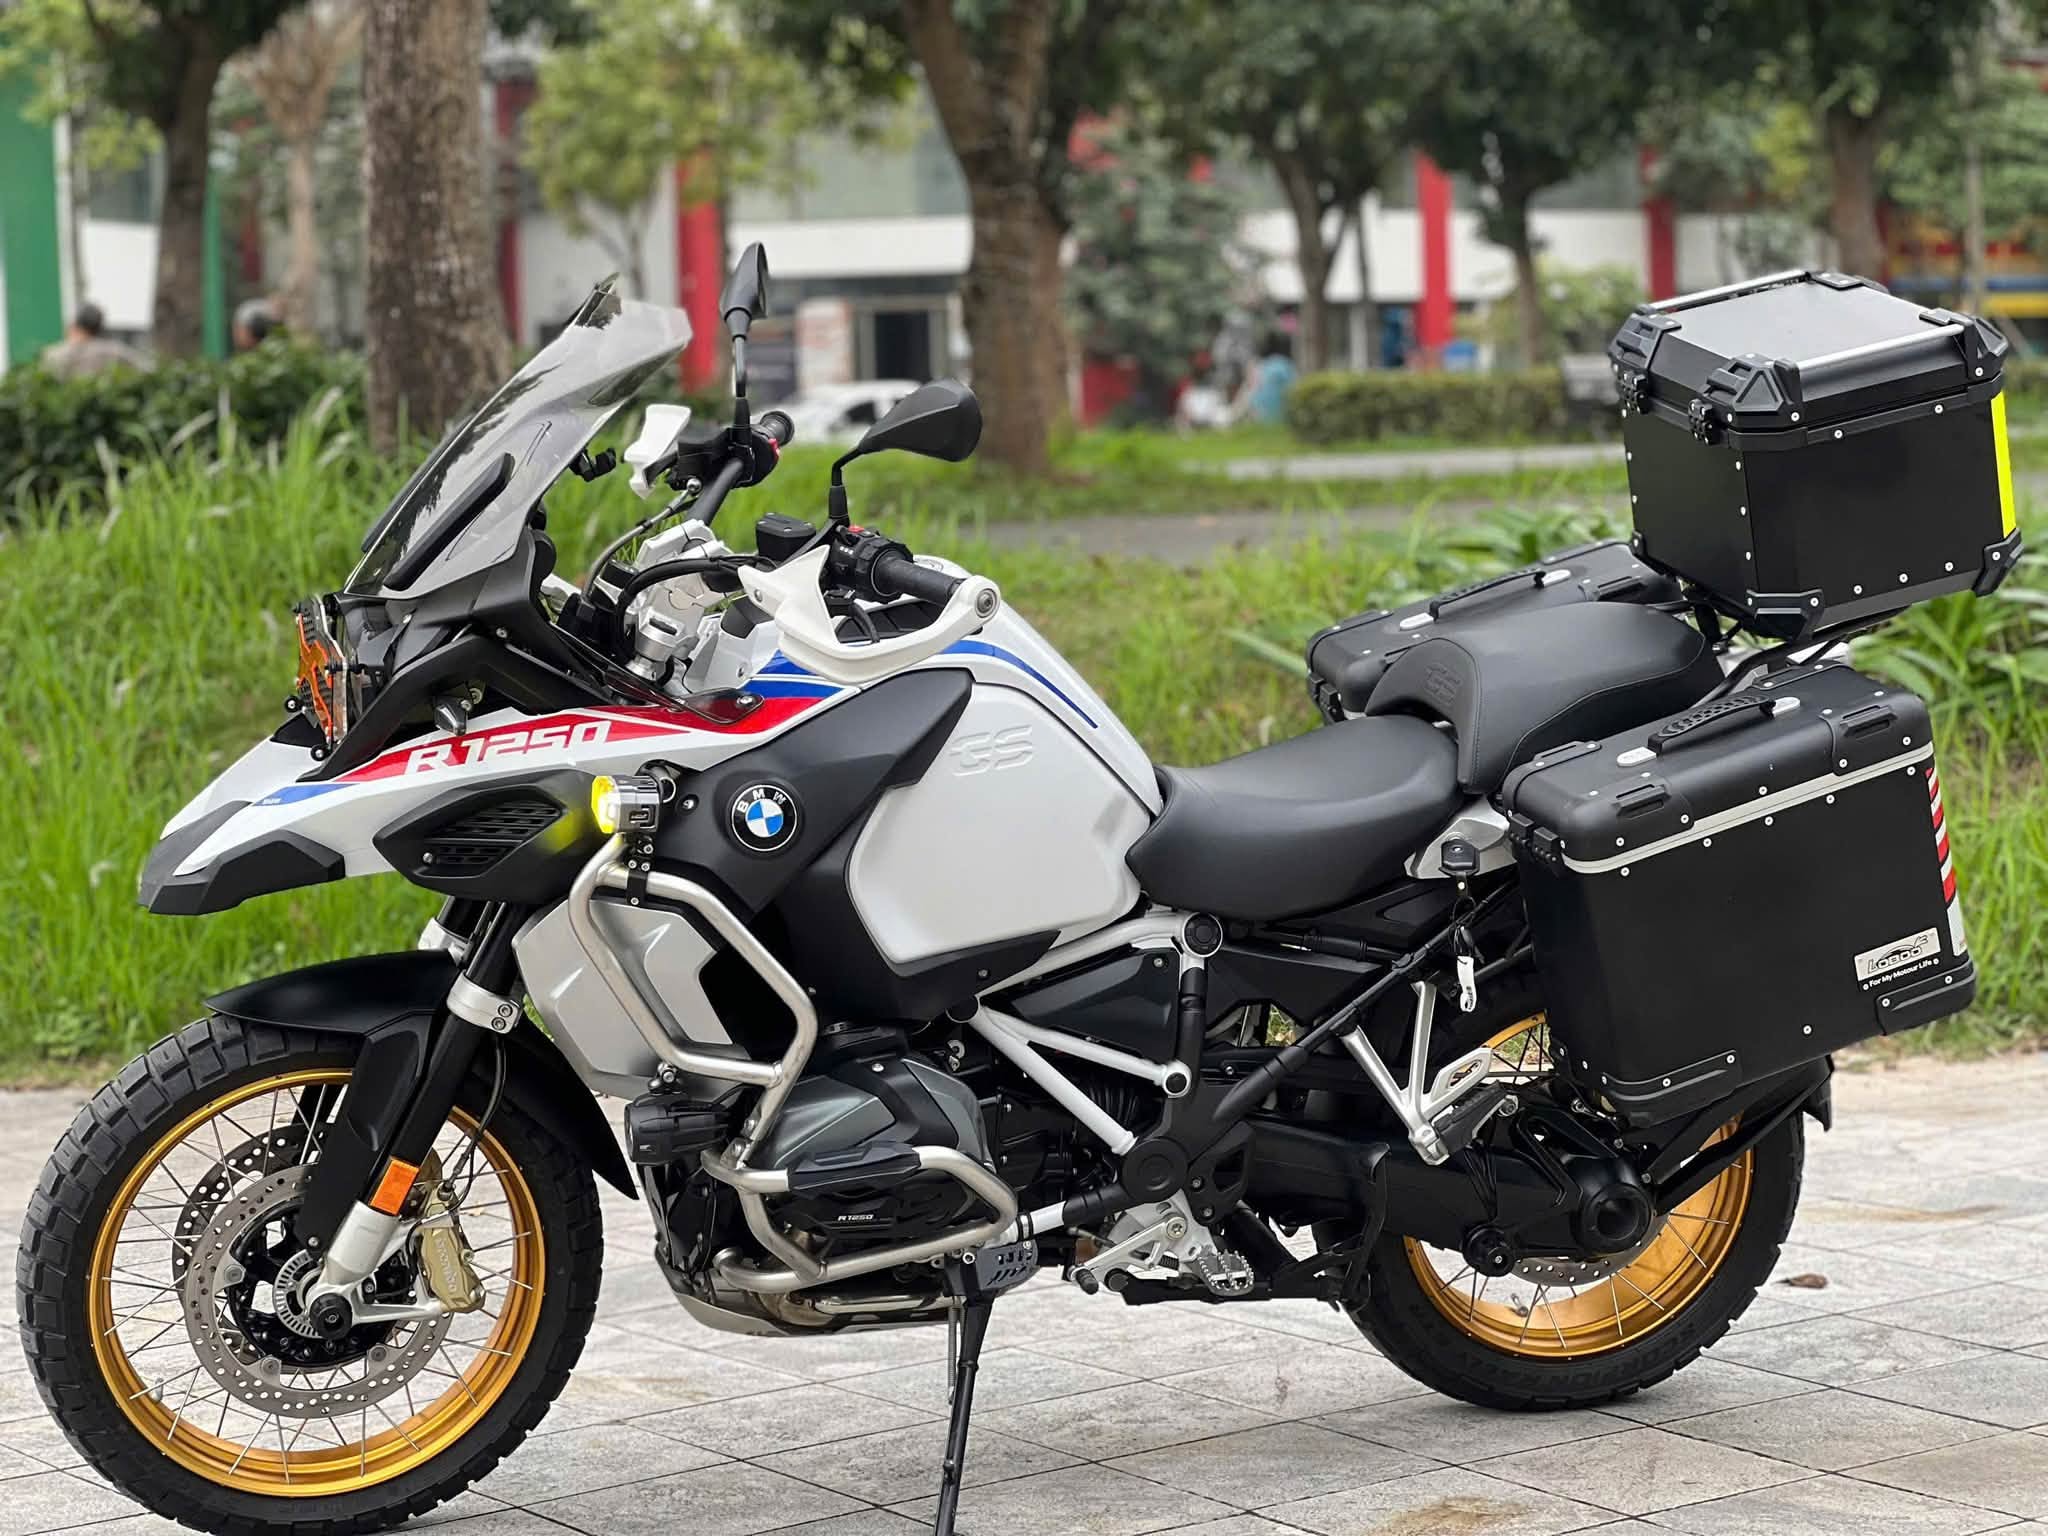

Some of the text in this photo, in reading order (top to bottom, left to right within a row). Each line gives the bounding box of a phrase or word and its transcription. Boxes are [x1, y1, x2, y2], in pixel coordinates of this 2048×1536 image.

[950, 725, 1033, 776] GS
[737, 788, 787, 813] BMW
[1869, 978, 1881, 988] For
[1881, 974, 1893, 982] My
[1918, 958, 1932, 969] Life
